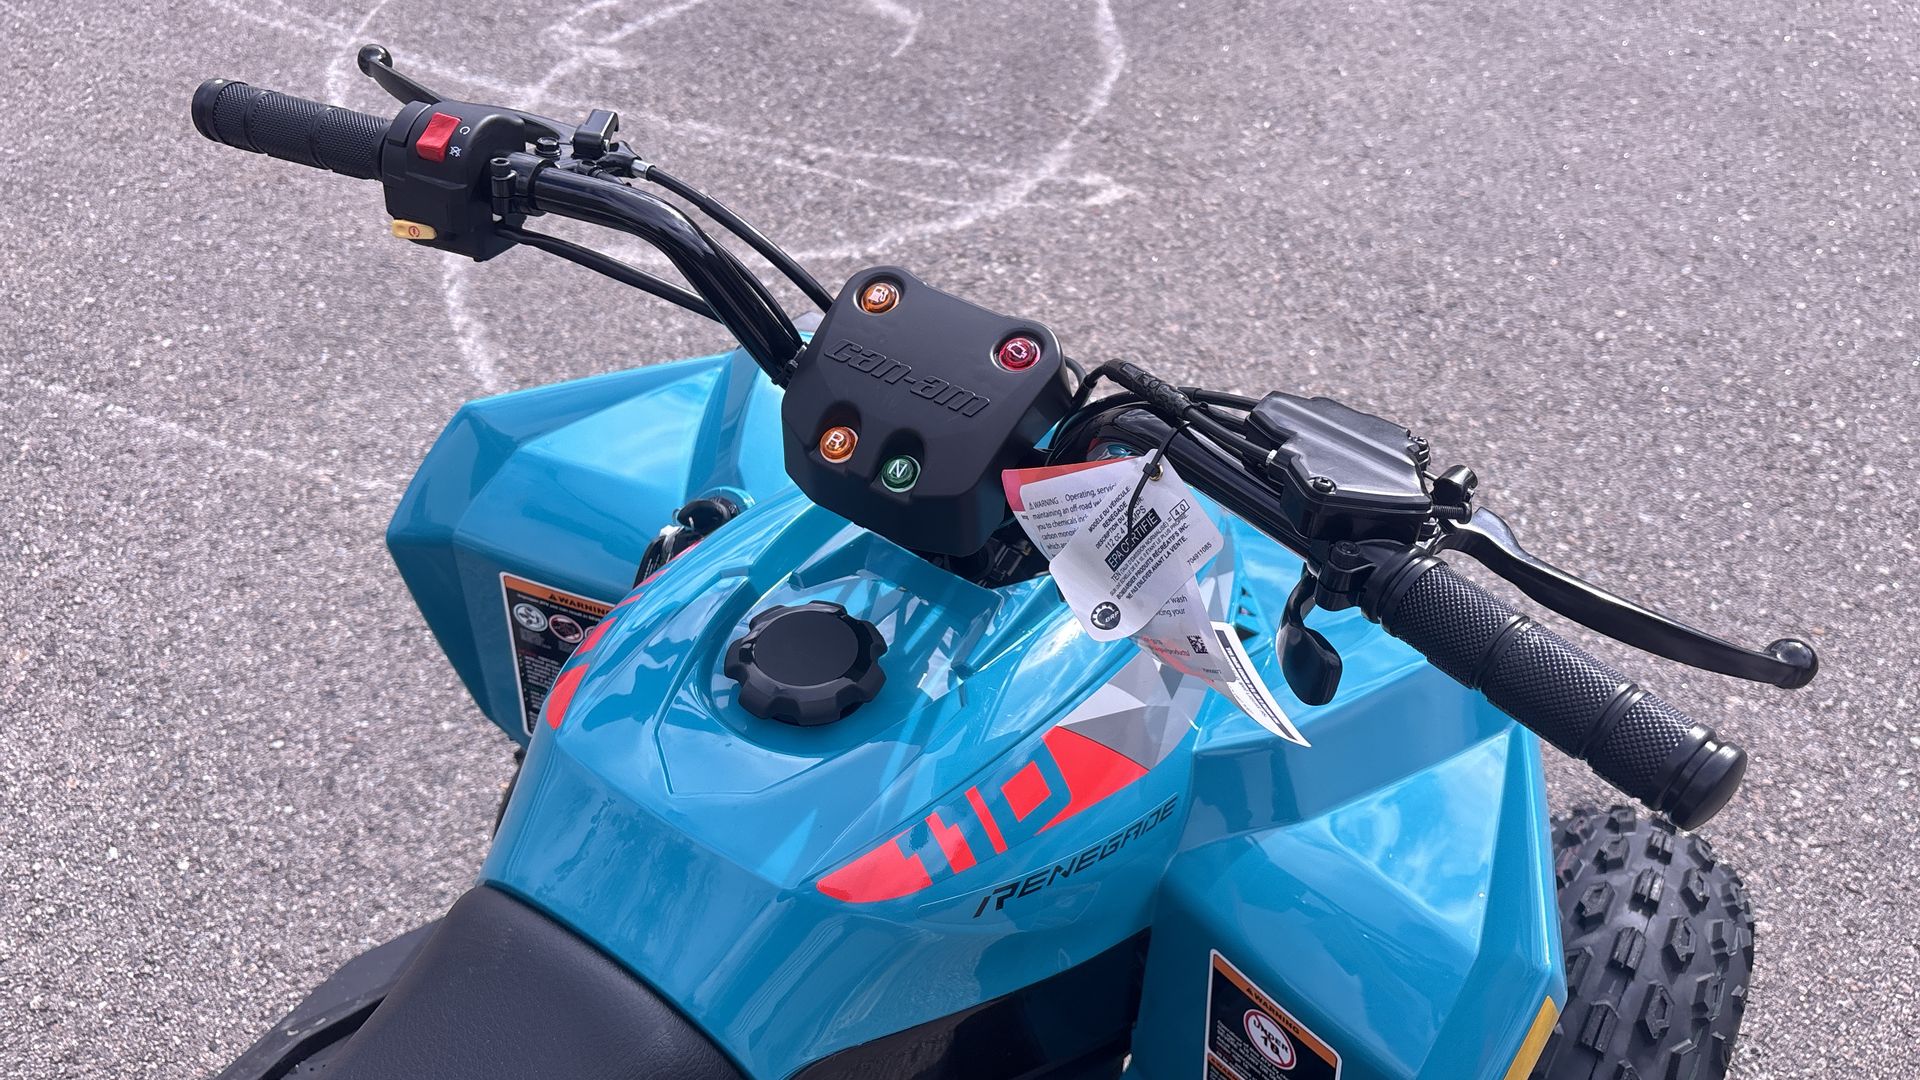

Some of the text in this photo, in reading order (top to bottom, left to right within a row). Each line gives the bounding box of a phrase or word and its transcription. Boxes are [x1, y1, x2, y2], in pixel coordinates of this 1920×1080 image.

[824, 339, 990, 417] can-am
[825, 430, 846, 448] R
[888, 460, 908, 478] N
[1064, 487, 1096, 503] Operating,
[1032, 508, 1062, 522] maintaining
[1069, 501, 1092, 512] off-road
[1101, 507, 1110, 516] DU
[1101, 500, 1128, 529] RENEGADE
[1037, 524, 1047, 533] you
[1051, 516, 1077, 528] chemicals
[1093, 521, 1120, 549] DESCRIPTION
[1116, 514, 1125, 523] DU
[1103, 538, 1116, 550] 112
[1113, 532, 1122, 541] cc
[1123, 504, 1147, 530] TMPS
[1041, 532, 1058, 542] carbon
[1046, 542, 1059, 551] which
[1106, 549, 1124, 568] EPA
[1133, 556, 1155, 578] PRODUITS
[1149, 530, 1180, 559] RÉCRÉATIFS
[1177, 521, 1190, 534] INC.
[1129, 585, 1139, 595] PAS
[1134, 569, 1154, 588] ENLEVER
[1149, 555, 1166, 571] AVANT
[1162, 550, 1172, 559] LA
[1168, 534, 1188, 553] VENTE.
[1110, 570, 1122, 582] TEN
[1170, 594, 1187, 603] wash
[973, 794, 1178, 919] RENEGADE
[1253, 994, 1301, 1034] WARNING
[1253, 1019, 1289, 1054] UNDER
